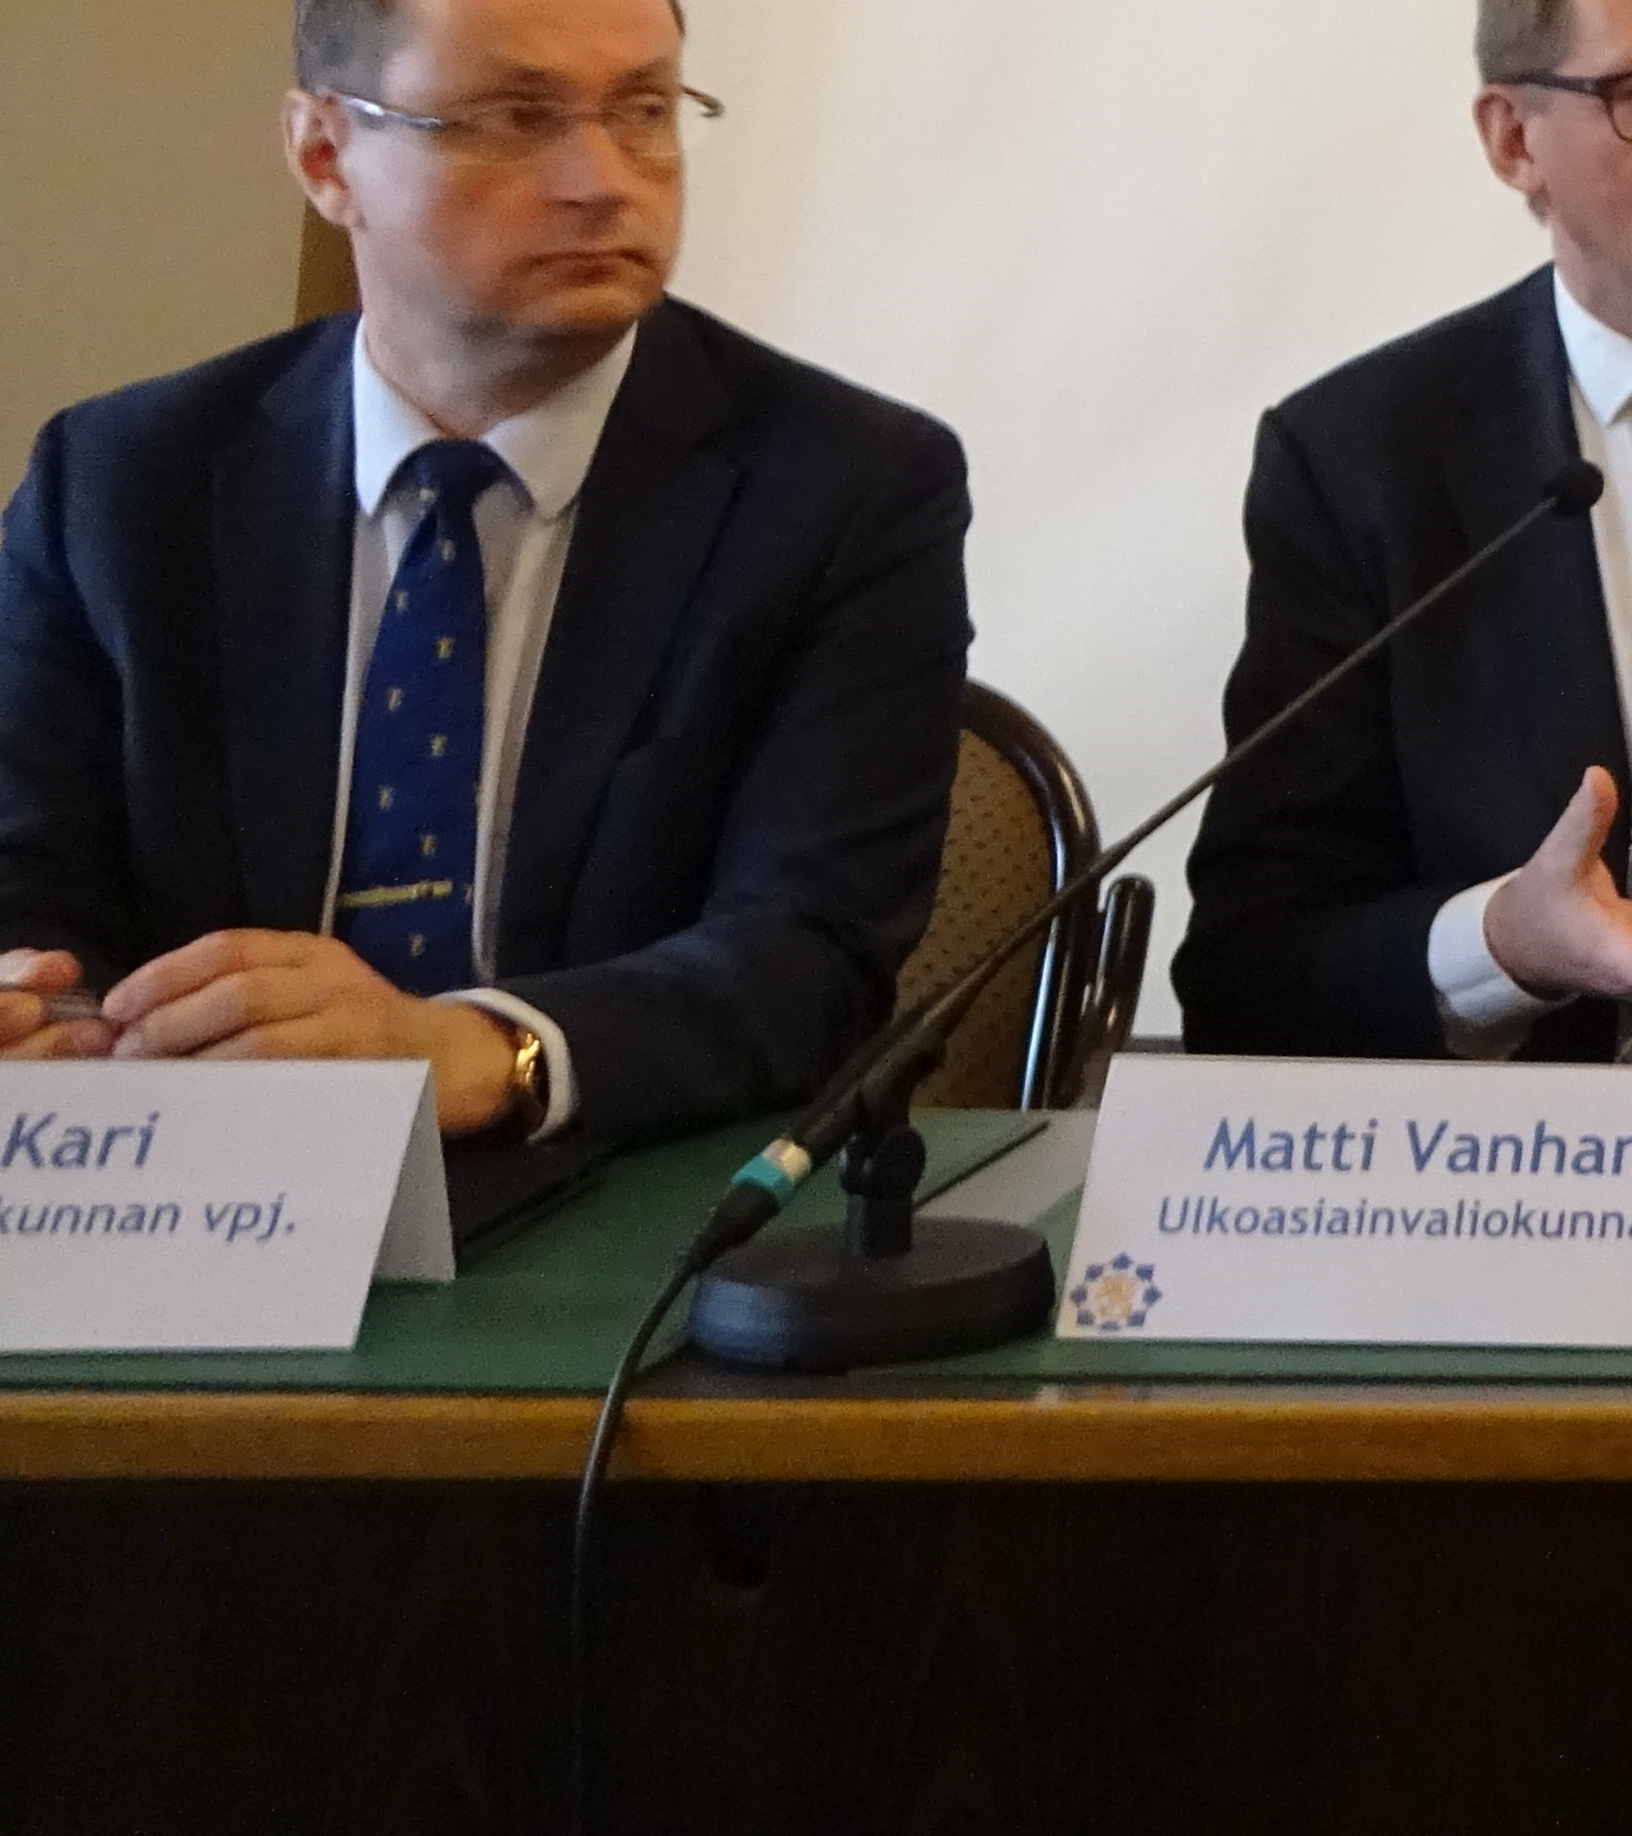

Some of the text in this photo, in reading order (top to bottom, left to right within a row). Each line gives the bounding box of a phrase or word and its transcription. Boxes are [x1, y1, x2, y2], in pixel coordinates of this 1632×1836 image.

[0, 1111, 160, 1170] Kari
[1203, 1116, 1378, 1171] Matti
[203, 1192, 295, 1243] vpj.
